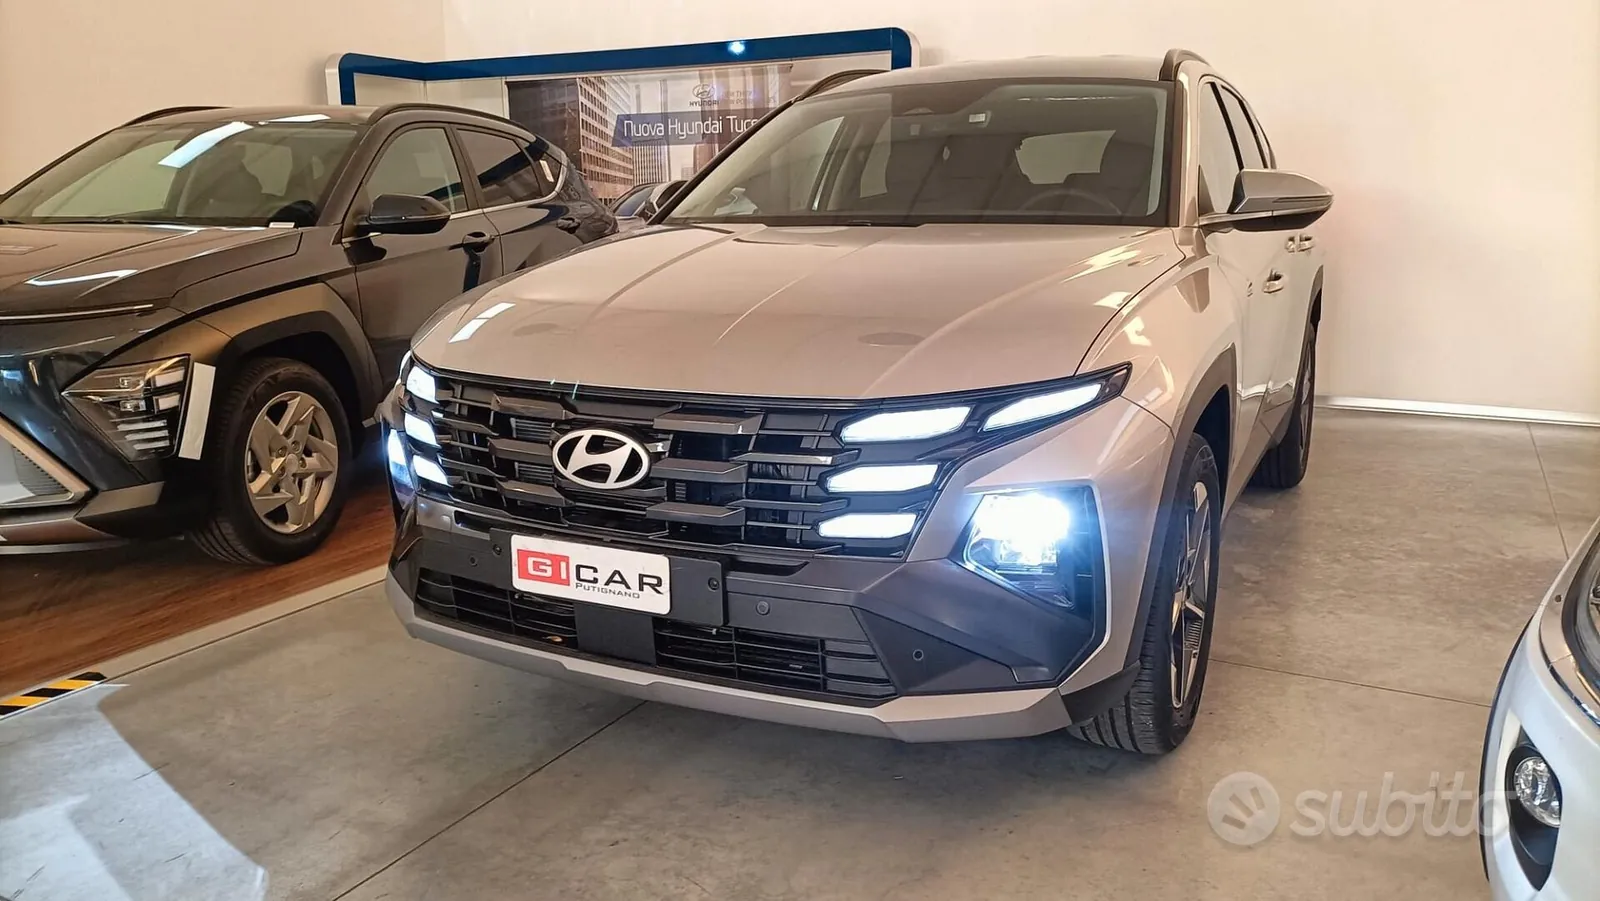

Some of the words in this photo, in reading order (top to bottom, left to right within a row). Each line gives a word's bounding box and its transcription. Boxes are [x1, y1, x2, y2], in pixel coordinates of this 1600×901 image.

[623, 120, 665, 137] Nuova
[668, 116, 723, 140] Hyundai
[575, 582, 641, 599] PUTIGNANO
